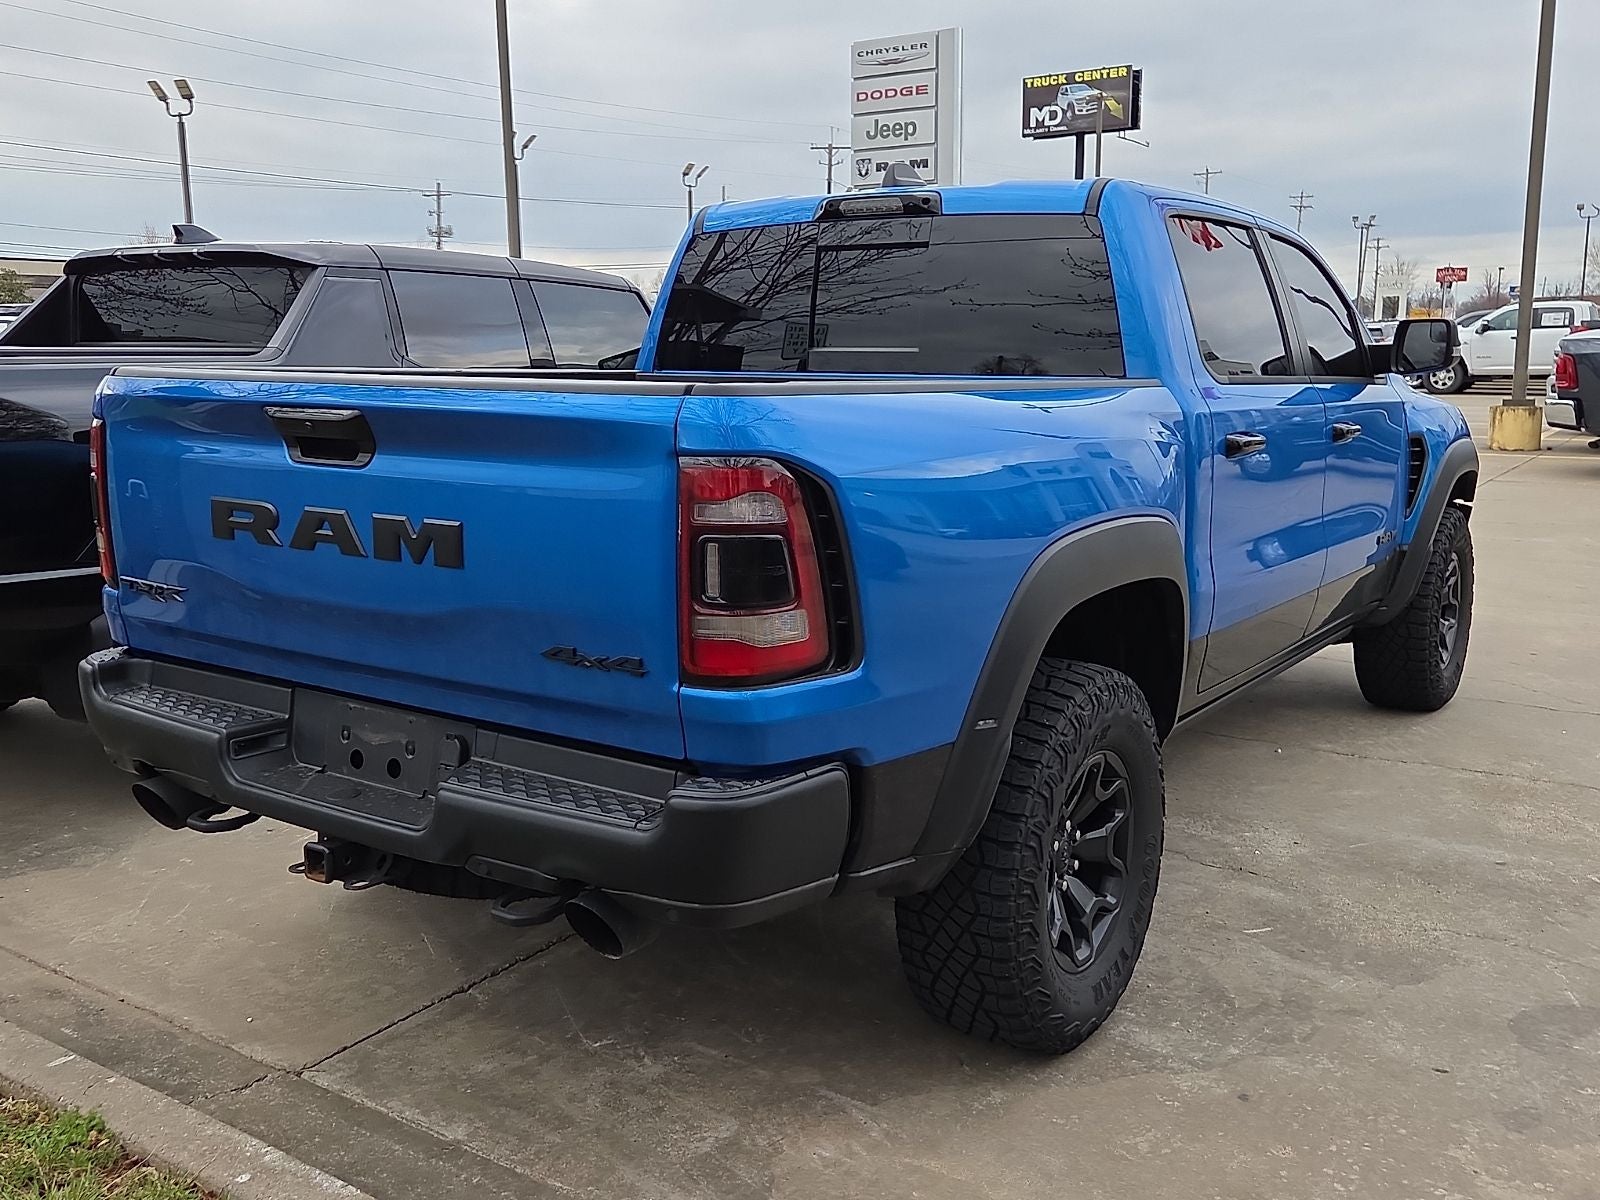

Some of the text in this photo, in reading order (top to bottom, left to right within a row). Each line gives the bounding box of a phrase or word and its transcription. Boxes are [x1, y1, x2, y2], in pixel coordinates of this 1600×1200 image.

[857, 42, 928, 58] CHRYSLER
[1025, 66, 1128, 89] TRUCK CENTER
[856, 84, 929, 102] DODGE
[1029, 105, 1063, 128] MD
[866, 118, 917, 141] Jeep
[876, 158, 929, 172] RM
[210, 496, 465, 570] RAM
